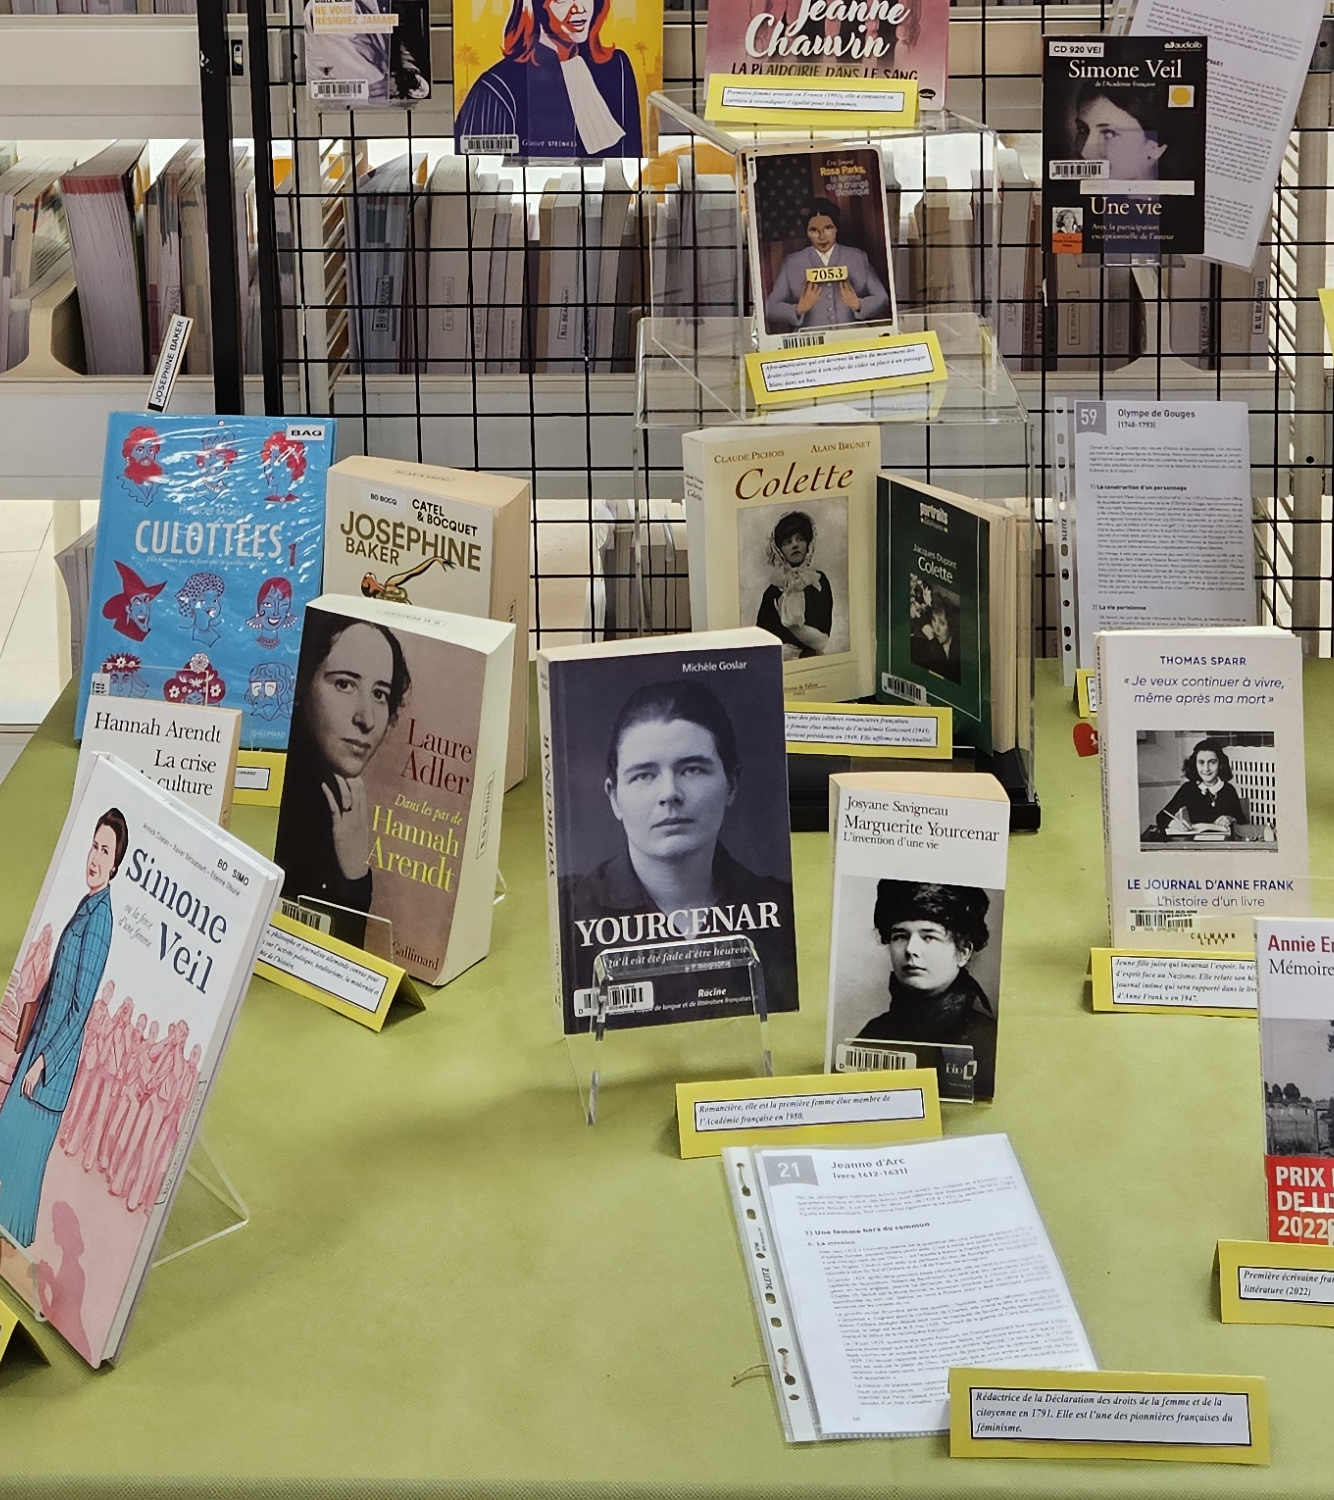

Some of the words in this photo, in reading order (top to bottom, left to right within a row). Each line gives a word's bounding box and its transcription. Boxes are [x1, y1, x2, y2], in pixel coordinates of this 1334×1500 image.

[314, 6, 327, 16] NE
[329, 6, 353, 15] VOUS
[315, 14, 358, 26] RÉSIGNEZ
[360, 15, 397, 25] JAMAIS
[745, 13, 890, 59] Chauvin
[1068, 60, 1139, 78] Simone
[1146, 60, 1182, 78] Veil
[1090, 197, 1130, 215] Une
[1136, 197, 1162, 215] vie
[812, 268, 844, 281] 7053
[154, 353, 175, 402] JOSEPHINE
[169, 320, 184, 350] BAKER
[1080, 409, 1097, 425] 59
[1118, 409, 1148, 421] Olympe
[1151, 409, 1161, 418] de
[1164, 409, 1196, 420] Gouges
[714, 453, 749, 464] CLAUDE
[751, 448, 785, 461] PICHOIS
[810, 443, 835, 454] ALAIN
[838, 439, 871, 451] BRUNET
[735, 462, 854, 500] Colette
[412, 499, 444, 516] CATEL
[417, 512, 425, 521] &
[427, 513, 477, 536] BOCQUET
[340, 511, 481, 572] JOSÉPHINE
[346, 538, 399, 566] BAKER
[288, 543, 297, 567] 1
[913, 543, 936, 559] Jacques
[937, 553, 957, 570] Dupont
[917, 556, 953, 583] Colette
[682, 662, 716, 673] Michèle
[717, 660, 747, 672] Goslar
[1160, 656, 1206, 665] THOMAS
[1211, 656, 1246, 666] SPARR
[1132, 675, 1147, 687] Je
[1151, 677, 1178, 687] veux
[1182, 675, 1239, 688] continuer
[1242, 675, 1250, 687] à
[1254, 675, 1285, 689] vivre,
[1134, 693, 1172, 704] même
[1176, 693, 1210, 706] après
[1214, 695, 1233, 704] ma
[94, 712, 160, 737] Hannah
[165, 720, 221, 744] Arendt
[408, 719, 472, 762] Laure
[154, 749, 176, 767] La
[180, 753, 216, 773] crise
[157, 775, 213, 796] culture
[401, 758, 470, 795] Adler
[395, 795, 419, 814] Dans
[422, 802, 433, 818] les
[434, 809, 449, 825] pas
[451, 813, 463, 827] de
[845, 796, 889, 816] Josyane
[892, 800, 949, 818] Savigneau
[372, 806, 459, 858] Hannah
[843, 815, 924, 838] Marguerite
[928, 822, 999, 842] Yourcenar
[843, 832, 895, 846] L'invention
[897, 835, 924, 848] d'une
[926, 839, 939, 850] vie
[217, 859, 228, 871] BD
[232, 869, 249, 886] SIMO
[366, 842, 455, 893] Arendt
[126, 849, 227, 943] Simone
[1127, 879, 1140, 890] LE
[1145, 879, 1202, 890] JOURNAL
[1205, 879, 1249, 890] D'ANNE
[1254, 879, 1294, 891] FRANK
[1157, 896, 1208, 907] L'histoire
[1212, 896, 1233, 907] d'un
[1237, 896, 1265, 907] livre
[575, 901, 781, 948] YOURCENAR
[1268, 935, 1315, 953] Annie
[157, 921, 212, 995] Veil
[777, 1161, 801, 1178] 21
[831, 1159, 873, 1170] Jeanne
[1276, 1166, 1326, 1188] PRIX
[1277, 1191, 1305, 1211] DE
[1277, 1215, 1328, 1238] 2022
[1243, 1271, 1280, 1281] Première
[1282, 1273, 1318, 1283] écrivaine
[1243, 1285, 1284, 1295] littérature
[1285, 1287, 1311, 1297] (2022)
